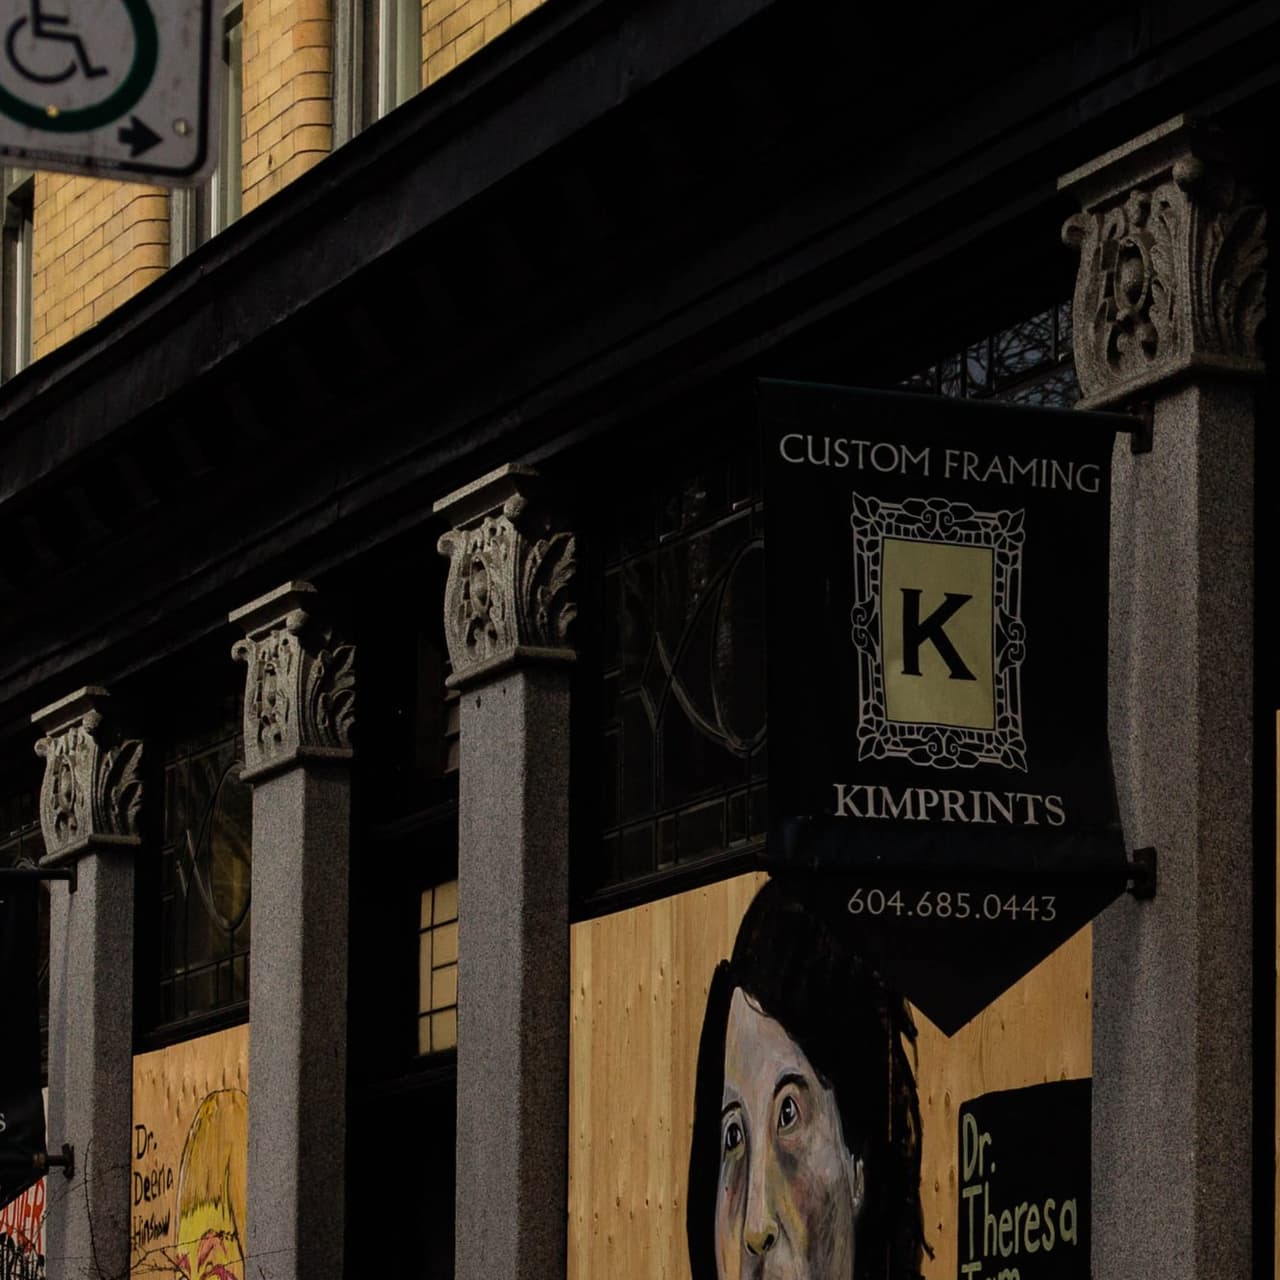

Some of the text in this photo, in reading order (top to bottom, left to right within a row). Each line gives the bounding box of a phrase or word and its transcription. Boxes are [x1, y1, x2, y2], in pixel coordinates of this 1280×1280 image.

[779, 433, 1101, 494] CUSTOM FRAMING
[899, 587, 977, 682] K
[832, 783, 1067, 826] KIMPRINTS
[847, 887, 1057, 922] 604.685.0443
[134, 1123, 158, 1160] Dr.
[962, 1112, 996, 1183] Dr.
[962, 1181, 1078, 1260] Theresa
